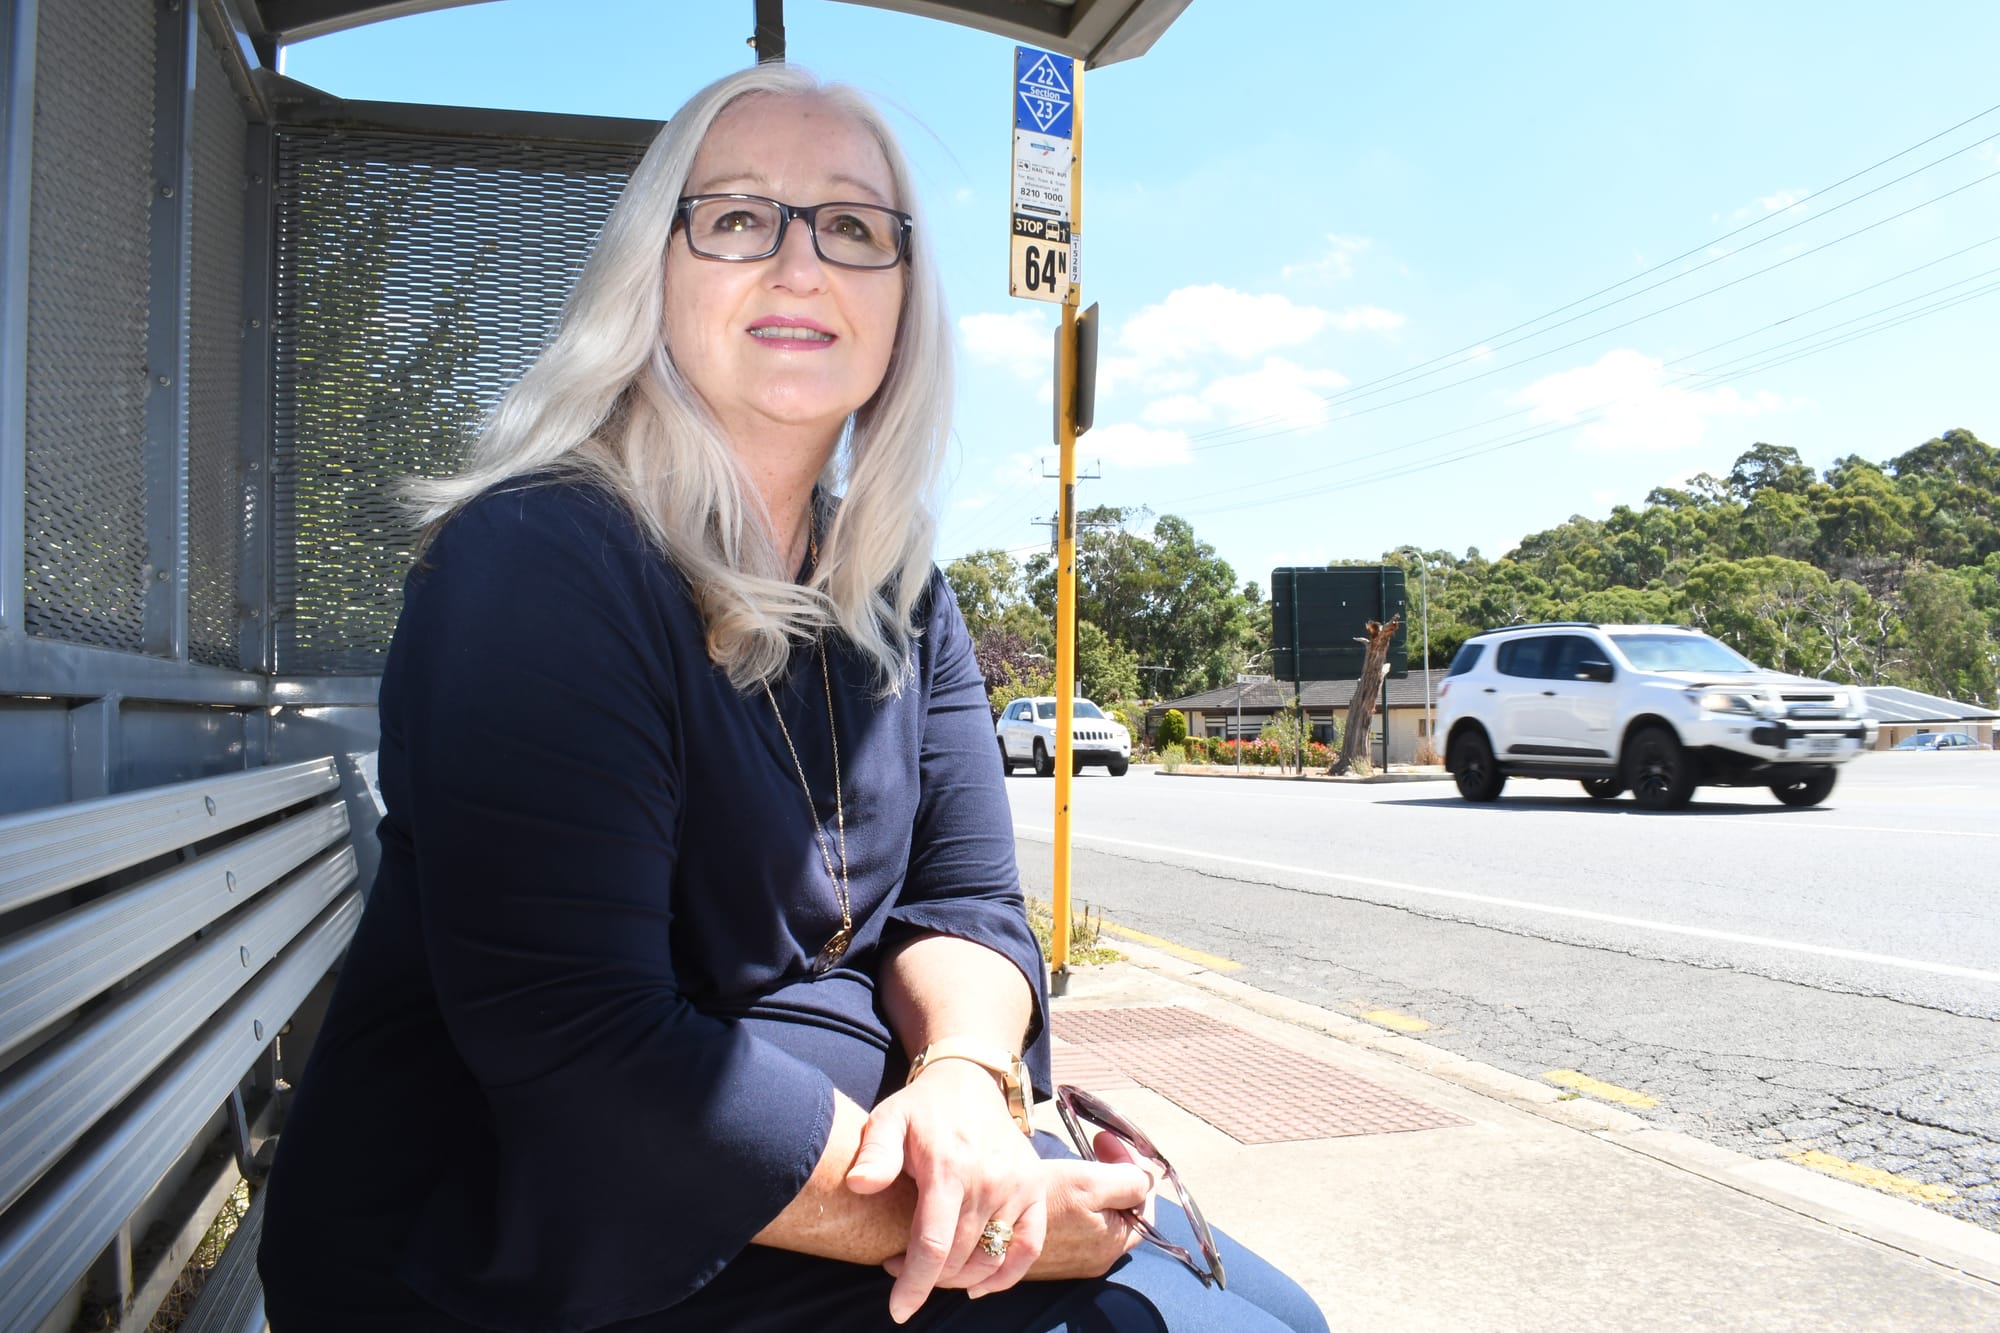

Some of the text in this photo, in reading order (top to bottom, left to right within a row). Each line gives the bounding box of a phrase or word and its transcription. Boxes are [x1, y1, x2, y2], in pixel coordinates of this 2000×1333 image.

[1037, 66, 1054, 86] 22
[1030, 86, 1060, 101] Section
[1036, 100, 1053, 119] 23
[1020, 187, 1063, 202] 8210 1000
[1015, 218, 1044, 234] STOP
